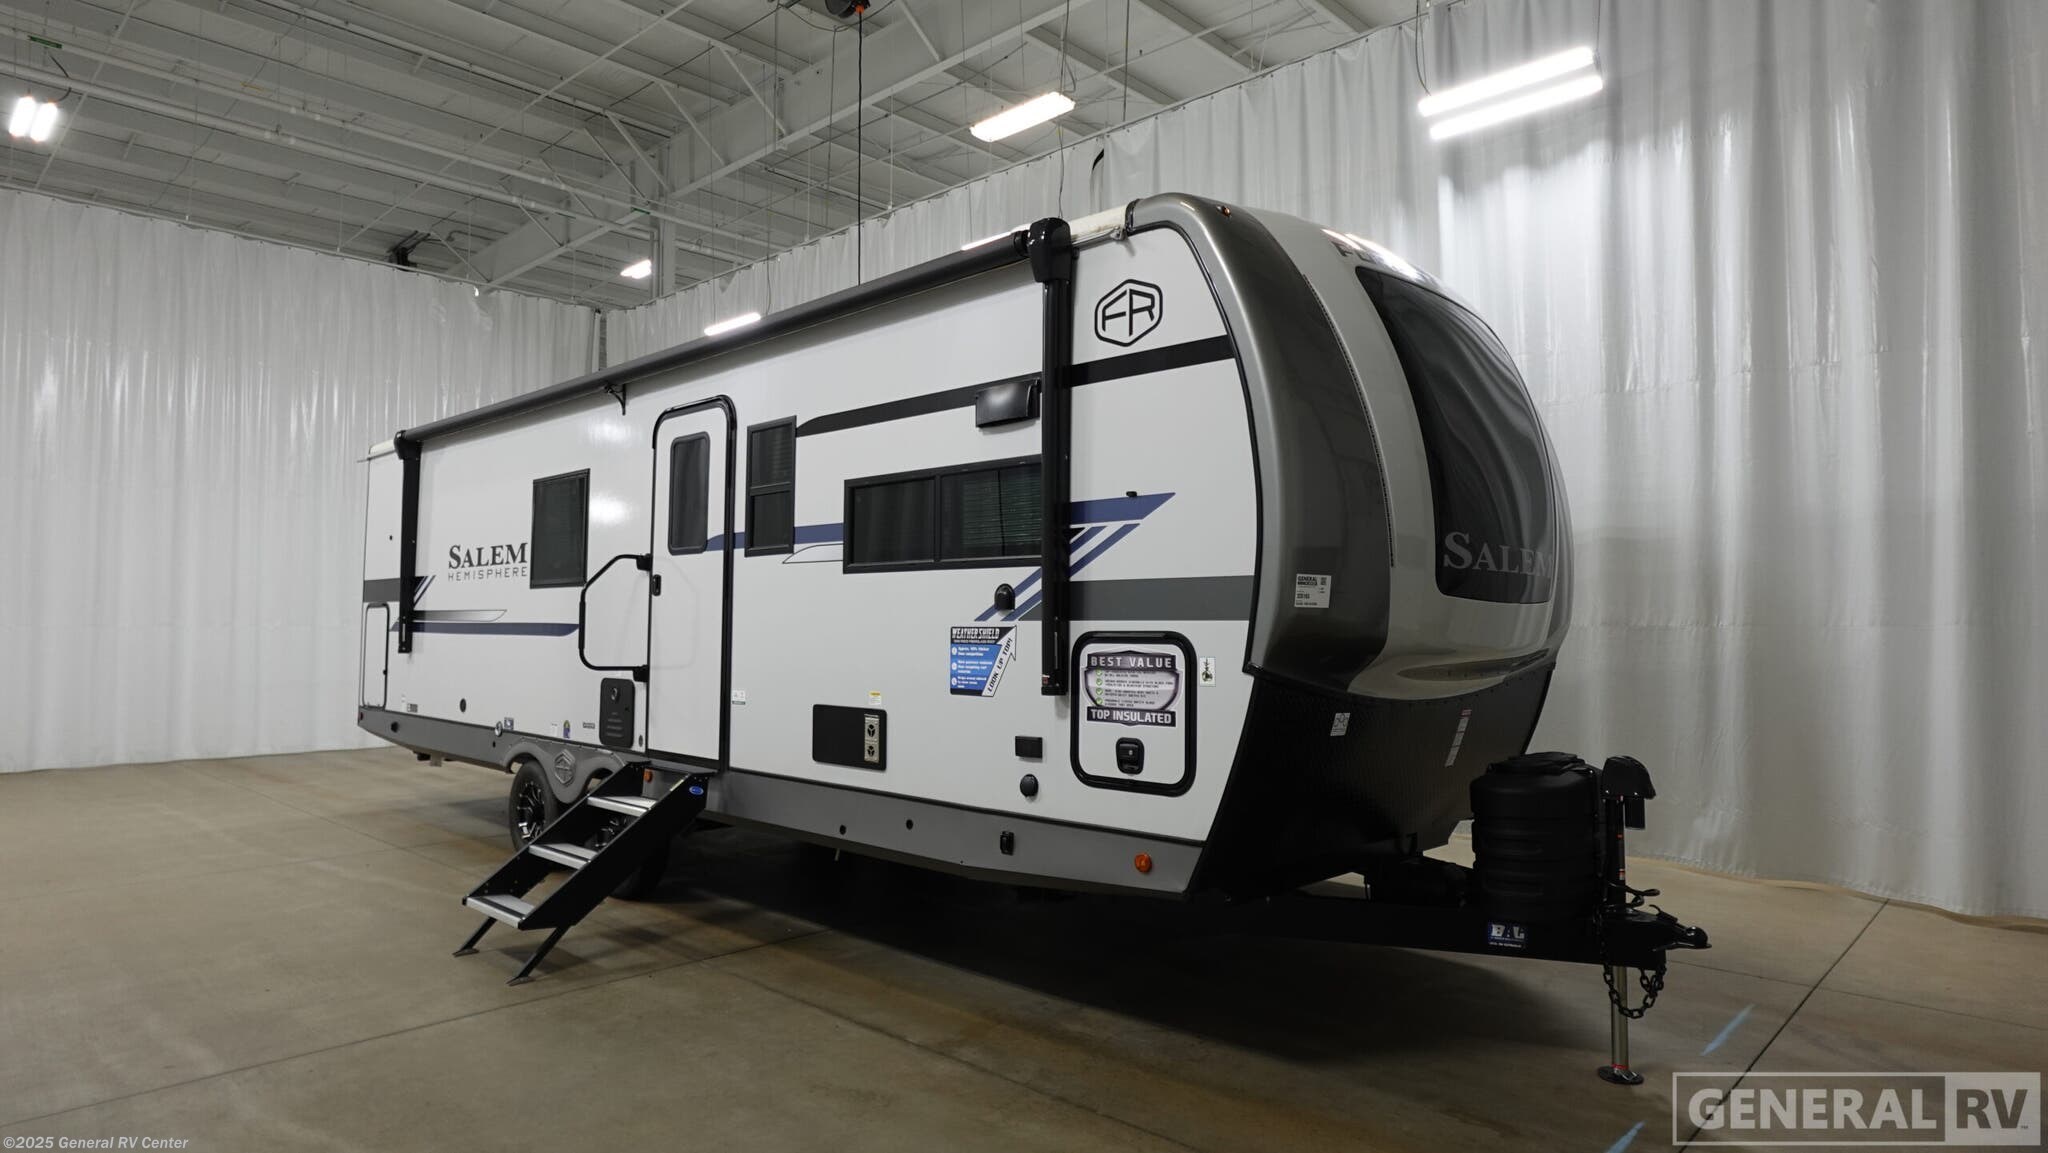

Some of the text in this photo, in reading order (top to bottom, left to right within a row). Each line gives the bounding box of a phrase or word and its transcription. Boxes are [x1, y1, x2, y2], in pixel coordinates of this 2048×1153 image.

[448, 542, 528, 569] SALEM
[1443, 531, 1553, 578] SALEM
[447, 566, 528, 581] HEMISPHERE
[987, 638, 1013, 692] LOOK UP TOP!
[1090, 655, 1172, 668] BEST VALUE
[1090, 709, 1172, 724] TOP INSULATED
